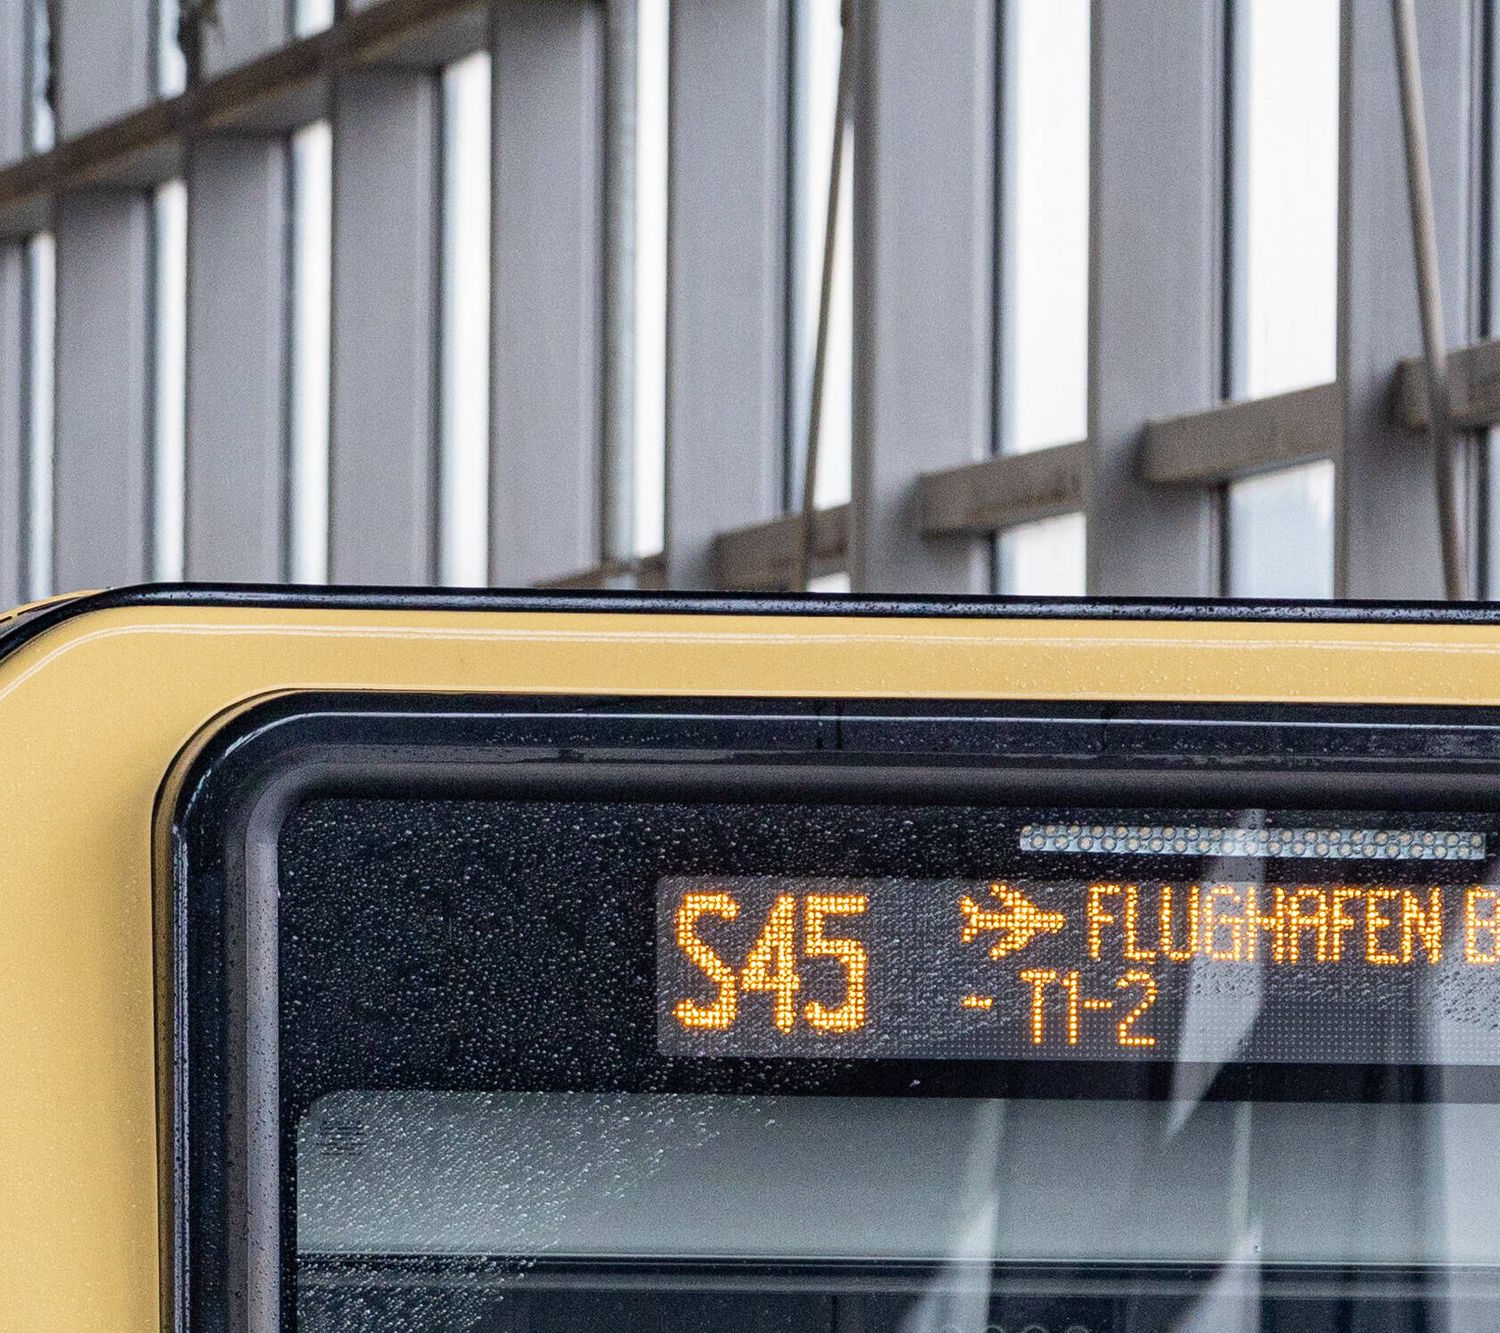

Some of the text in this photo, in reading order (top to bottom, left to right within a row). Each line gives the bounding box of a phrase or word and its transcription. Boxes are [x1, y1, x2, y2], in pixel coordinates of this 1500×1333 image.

[673, 893, 868, 1034] S45
[1086, 884, 1441, 966] FLUGHAFEN
[1020, 969, 1159, 1046] T1-2
